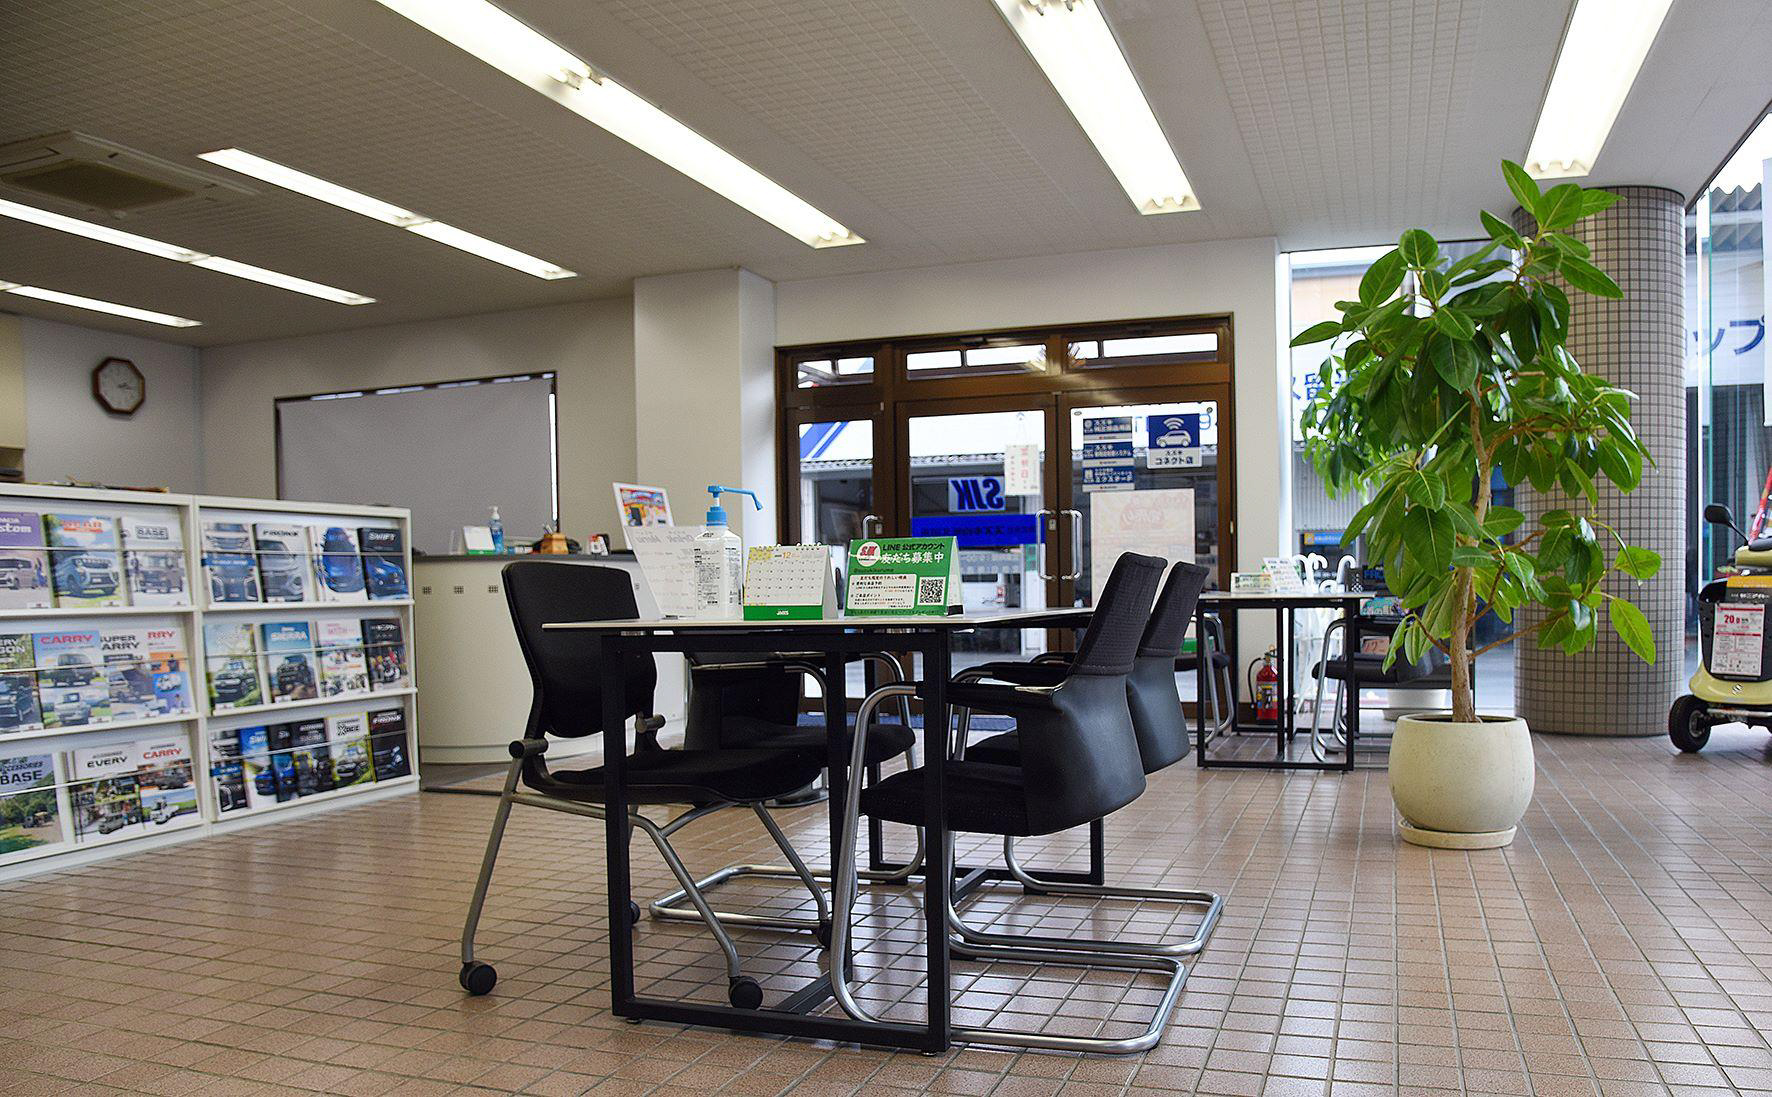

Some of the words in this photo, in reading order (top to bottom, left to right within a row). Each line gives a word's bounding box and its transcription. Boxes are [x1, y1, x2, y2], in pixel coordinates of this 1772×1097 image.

[1685, 315, 1765, 355] ップ
[137, 528, 168, 537] BASE
[368, 533, 396, 541] SWIFT
[883, 543, 900, 551] LINE
[902, 543, 945, 551] 公式アカウント
[881, 552, 944, 564] 友だち募集中
[40, 634, 94, 644] CARRY
[100, 634, 136, 644] UPER
[147, 630, 176, 639] RRY
[101, 642, 140, 651] ARRY
[143, 747, 182, 760] CARRY
[87, 756, 128, 769] EVERY
[0, 769, 43, 785] BASE
